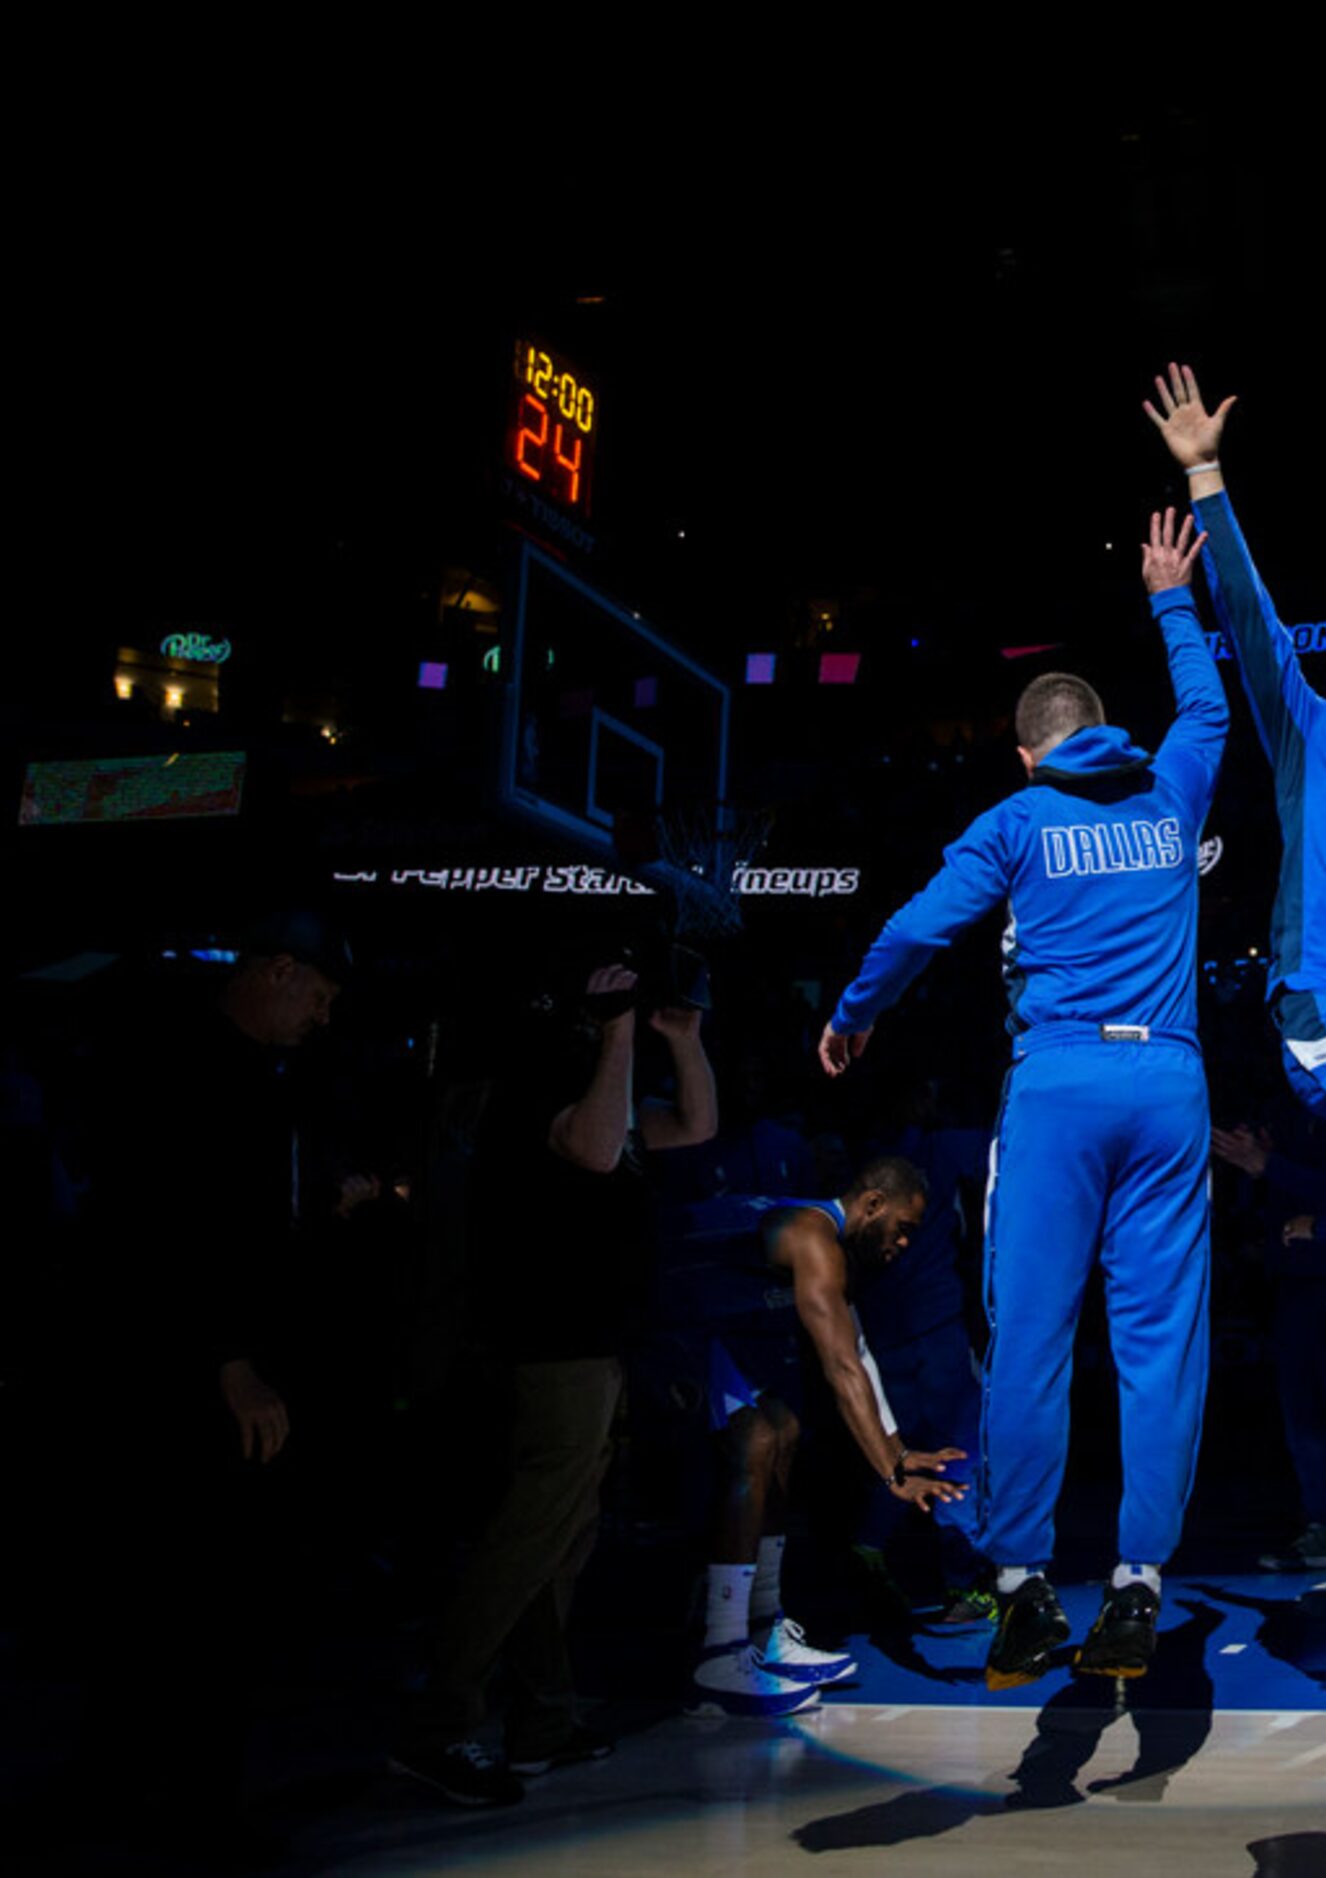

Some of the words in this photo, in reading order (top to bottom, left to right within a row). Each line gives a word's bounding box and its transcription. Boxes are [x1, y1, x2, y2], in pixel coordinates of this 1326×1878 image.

[524, 346, 595, 434] 12:00
[516, 392, 583, 504] 24
[1041, 817, 1183, 879] DALLAS
